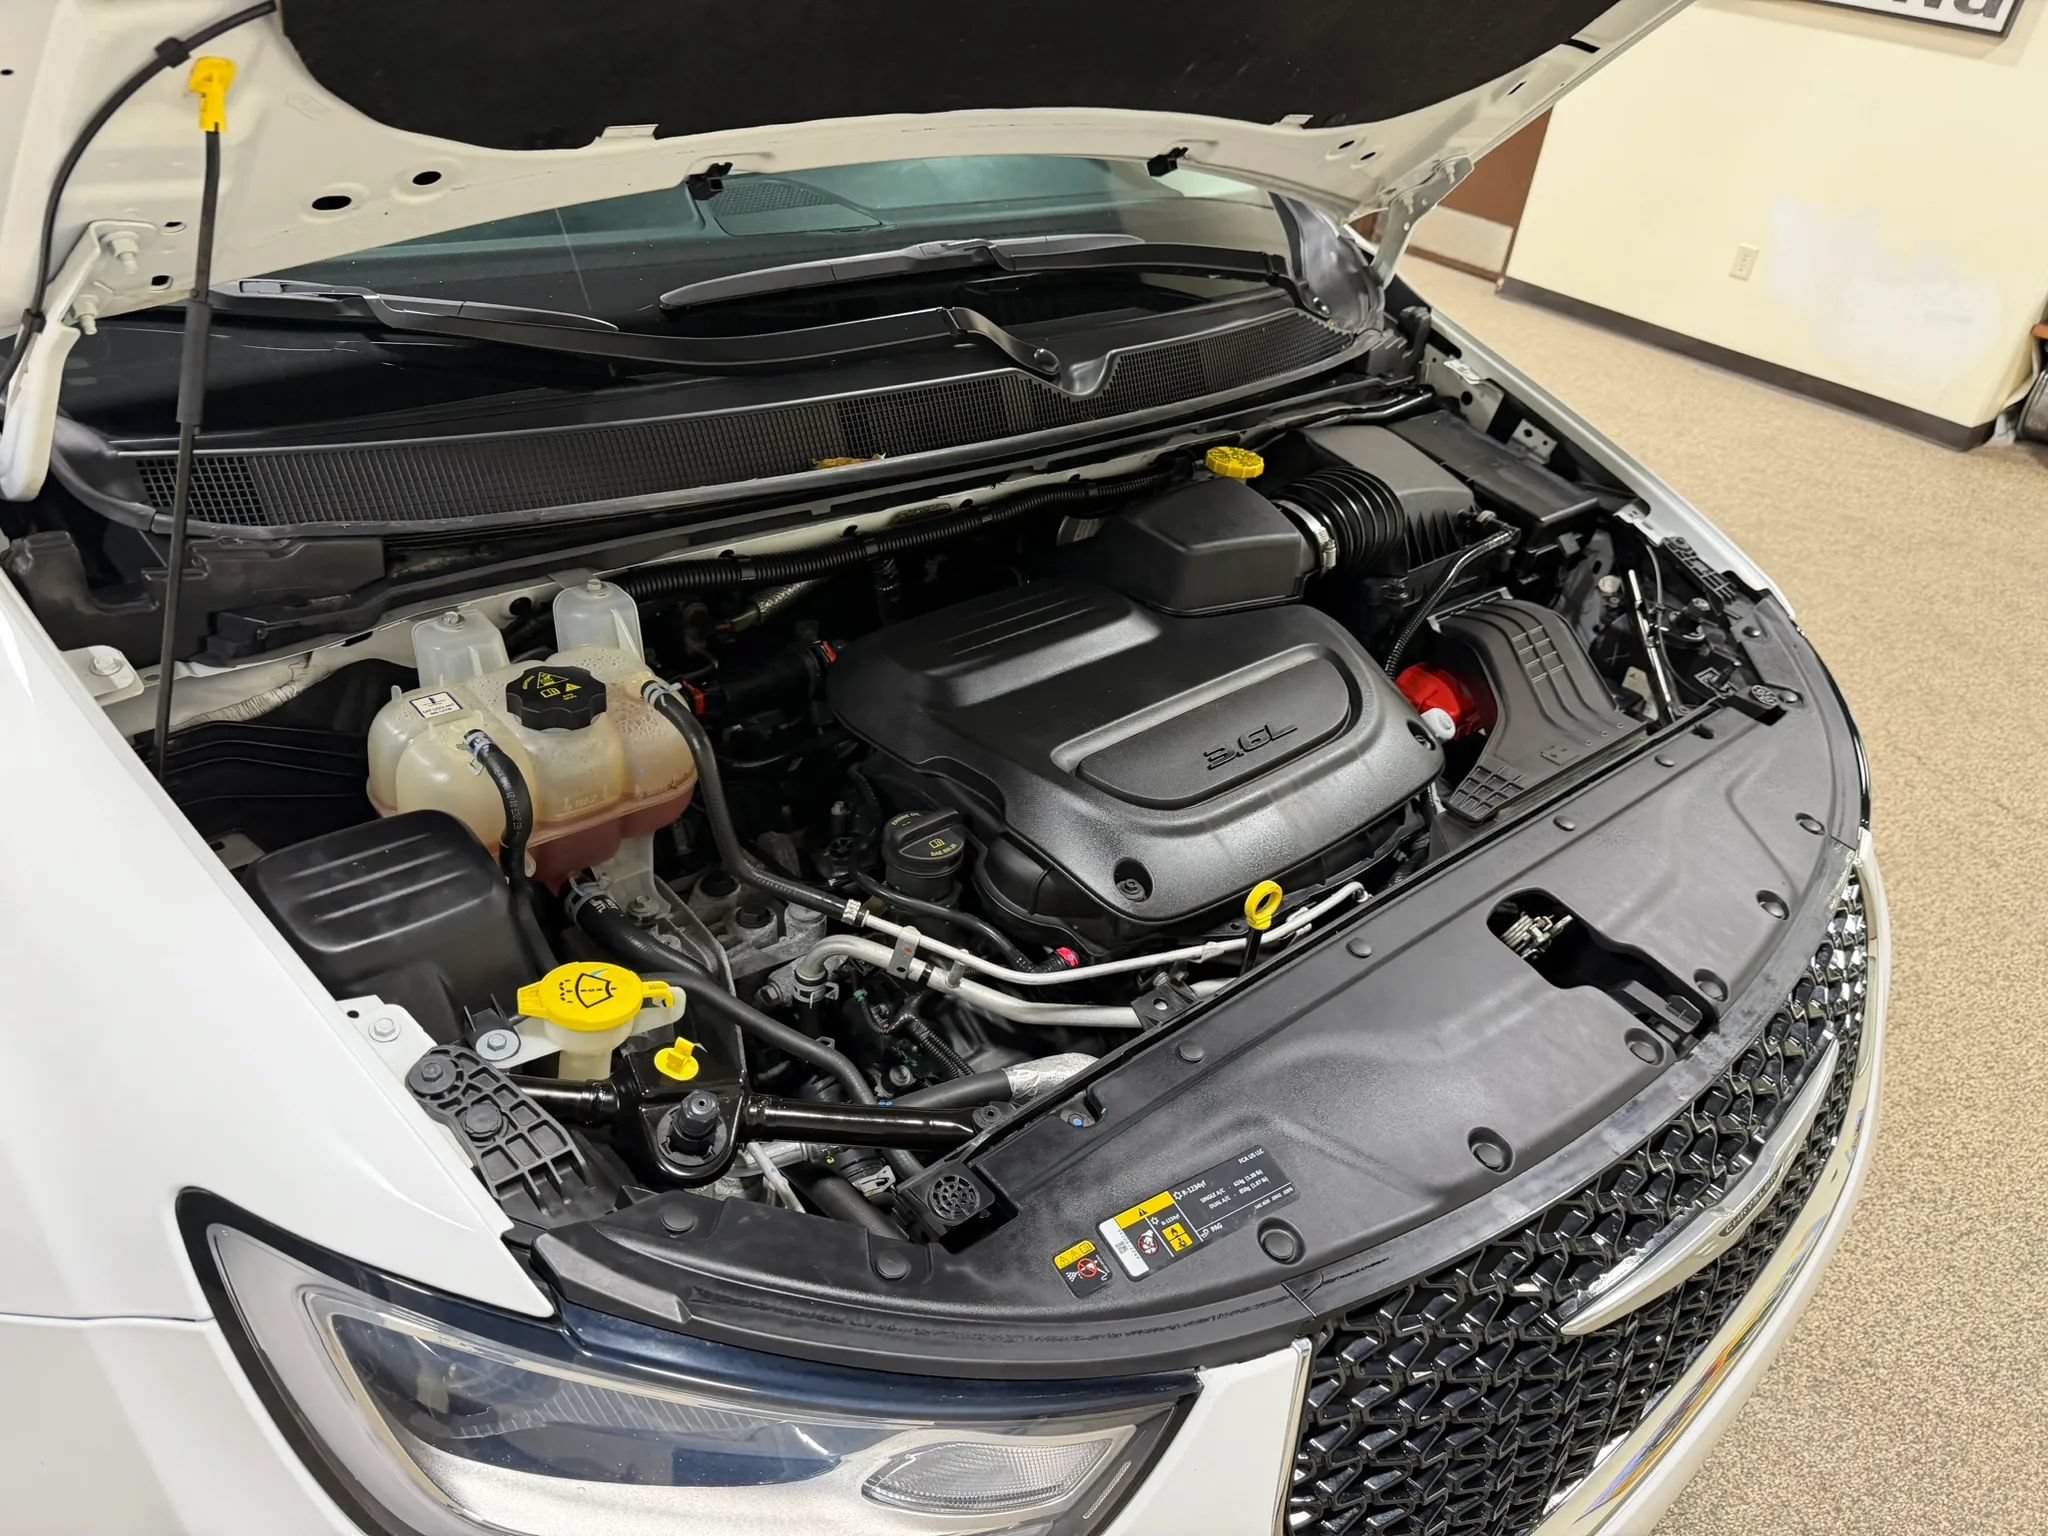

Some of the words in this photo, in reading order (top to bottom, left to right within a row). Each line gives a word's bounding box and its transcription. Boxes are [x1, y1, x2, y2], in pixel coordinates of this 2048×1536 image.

[1203, 724, 1298, 770] 3.6L
[1182, 1180, 1207, 1197] R-1234yf
[1200, 1192, 1216, 1203] SINGLE
[1215, 1187, 1226, 1197] A/C
[1208, 1200, 1222, 1210] DUAL
[1221, 1195, 1231, 1204] A/C
[1725, 1173, 1777, 1233] CHRYSLER
[1210, 1222, 1223, 1233] PAG
